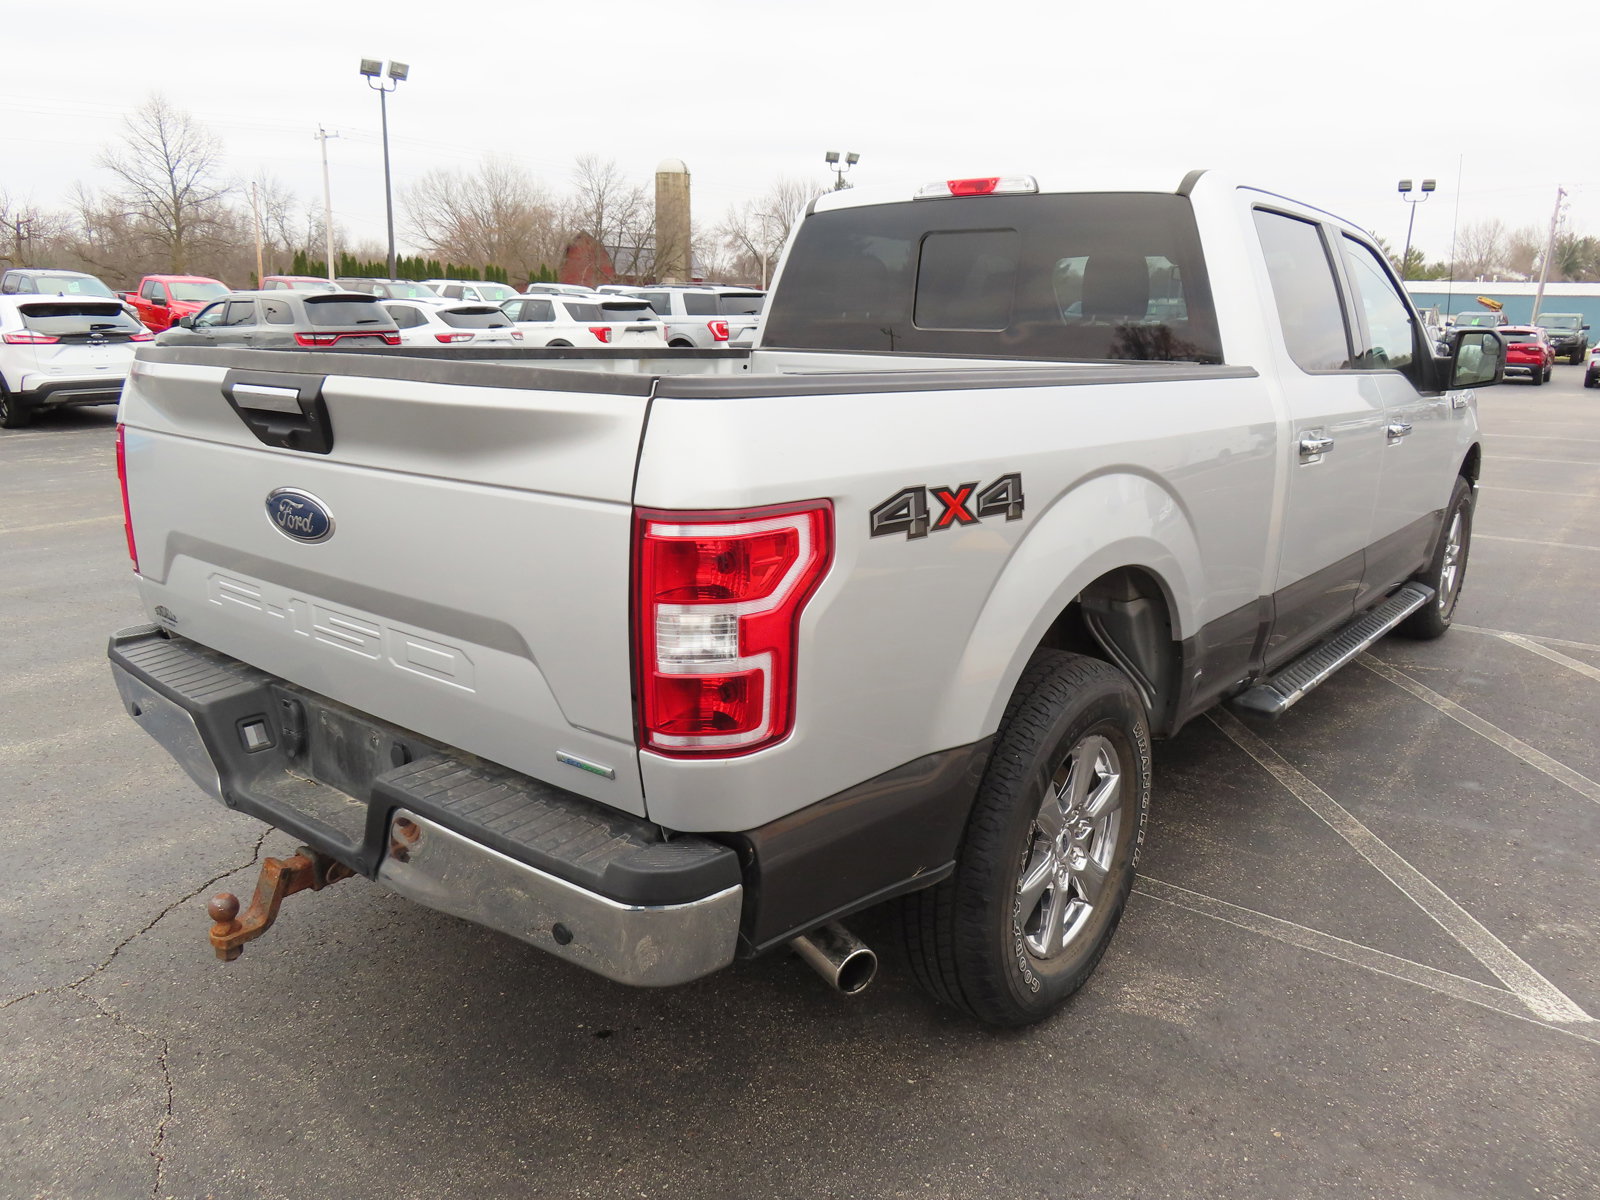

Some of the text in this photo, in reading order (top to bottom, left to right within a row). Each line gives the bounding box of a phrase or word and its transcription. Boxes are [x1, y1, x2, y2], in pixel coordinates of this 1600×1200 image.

[277, 498, 313, 533] Ford
[207, 572, 476, 694] F-150
[1132, 721, 1150, 869] WRANGLER
